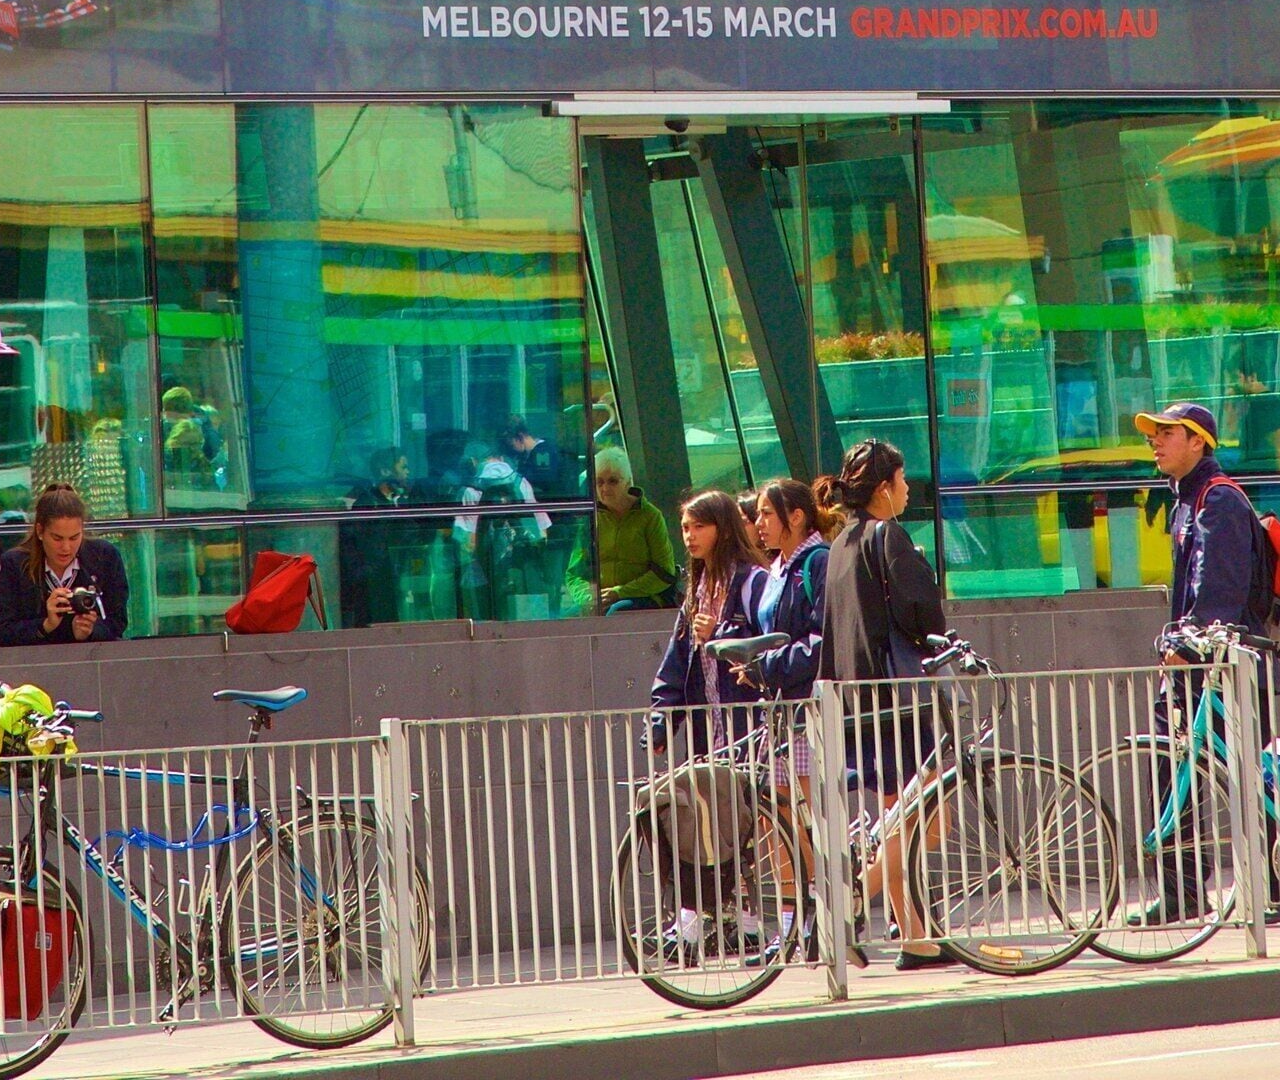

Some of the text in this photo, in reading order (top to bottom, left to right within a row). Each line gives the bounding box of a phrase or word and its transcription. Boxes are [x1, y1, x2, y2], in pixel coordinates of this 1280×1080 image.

[422, 5, 1159, 40] MELBOURNE 12-15 MARCH GRANDPRIX.COM.AU
